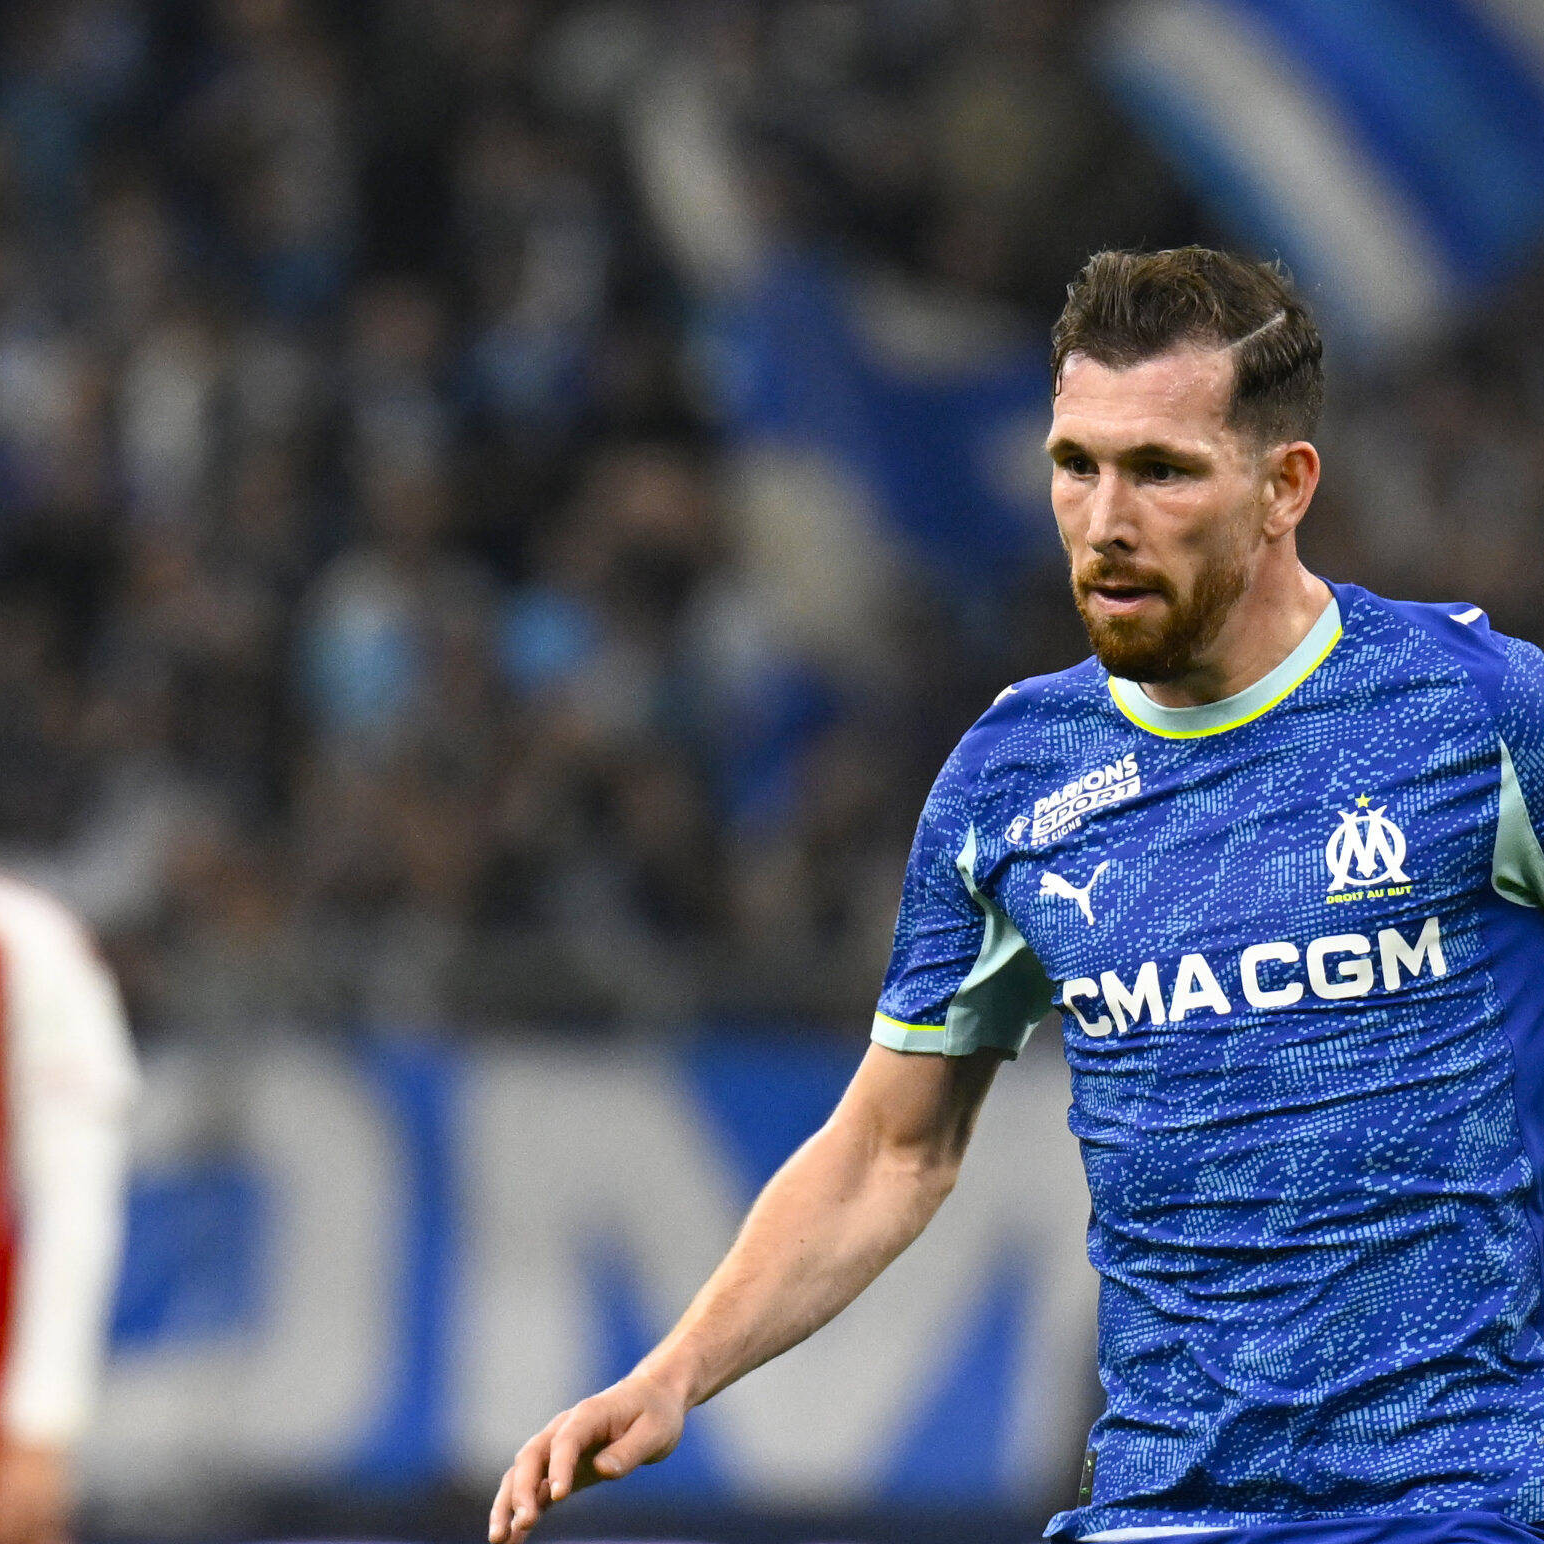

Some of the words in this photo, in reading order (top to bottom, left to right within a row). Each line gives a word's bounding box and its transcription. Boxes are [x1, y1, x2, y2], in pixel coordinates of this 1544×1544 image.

[1034, 752, 1138, 819] PARIONS
[1034, 777, 1140, 838] SPORT
[1051, 816, 1083, 842] LIGNE
[1326, 891, 1364, 904] DROIT
[1367, 889, 1385, 899] AU
[1387, 885, 1412, 897] BUT
[1062, 960, 1233, 1038] CMA
[1240, 916, 1448, 1009] CGM
